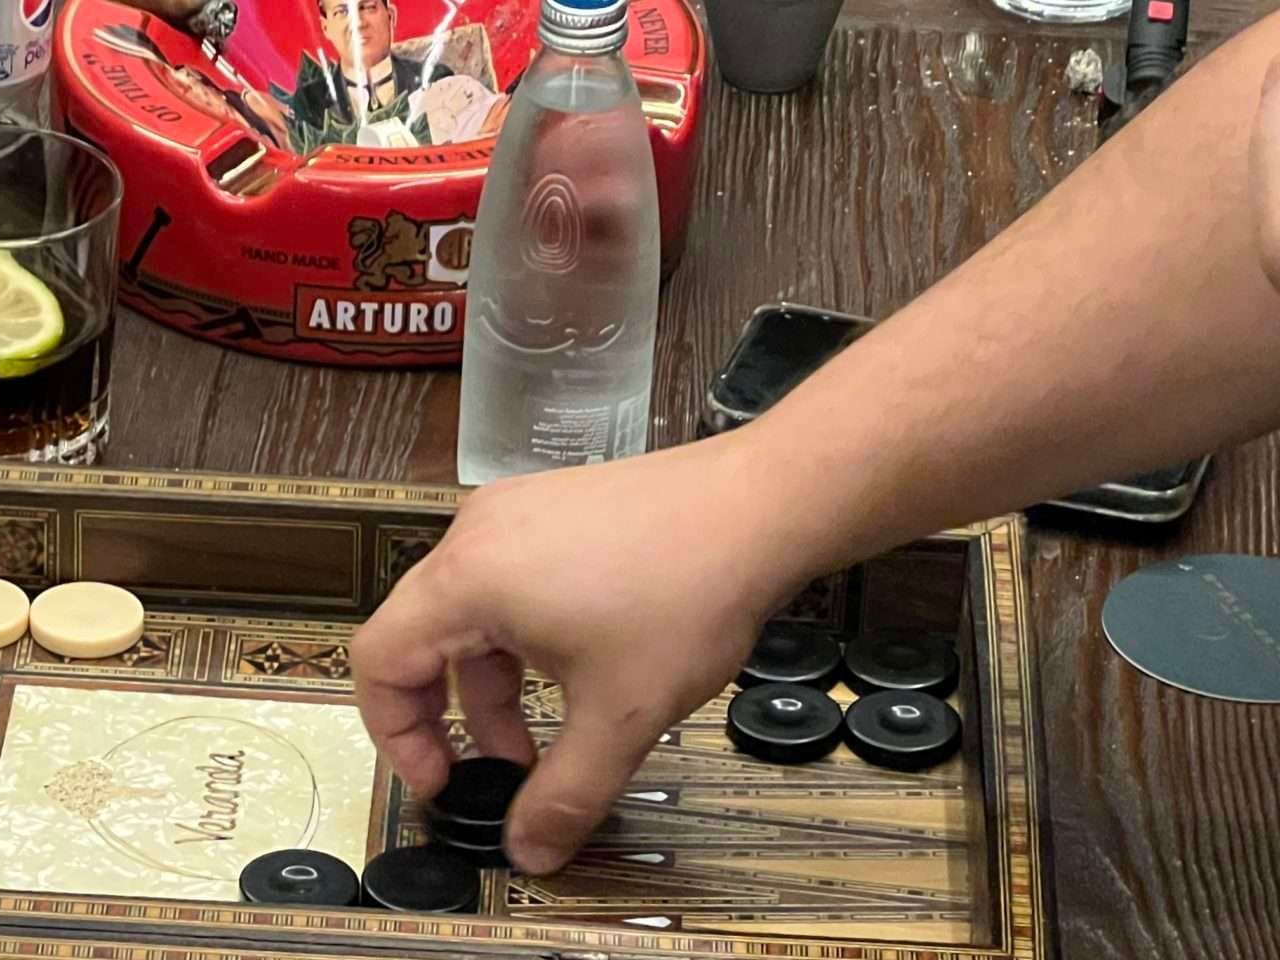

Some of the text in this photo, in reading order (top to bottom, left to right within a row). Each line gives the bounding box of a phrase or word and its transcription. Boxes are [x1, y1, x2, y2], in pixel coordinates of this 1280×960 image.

[633, 7, 669, 56] NEVER
[141, 104, 182, 122] OF
[335, 153, 447, 166] HANDS
[240, 246, 341, 270] HAND MADE
[308, 298, 454, 334] ARTURO
[173, 750, 246, 845] Veranda
